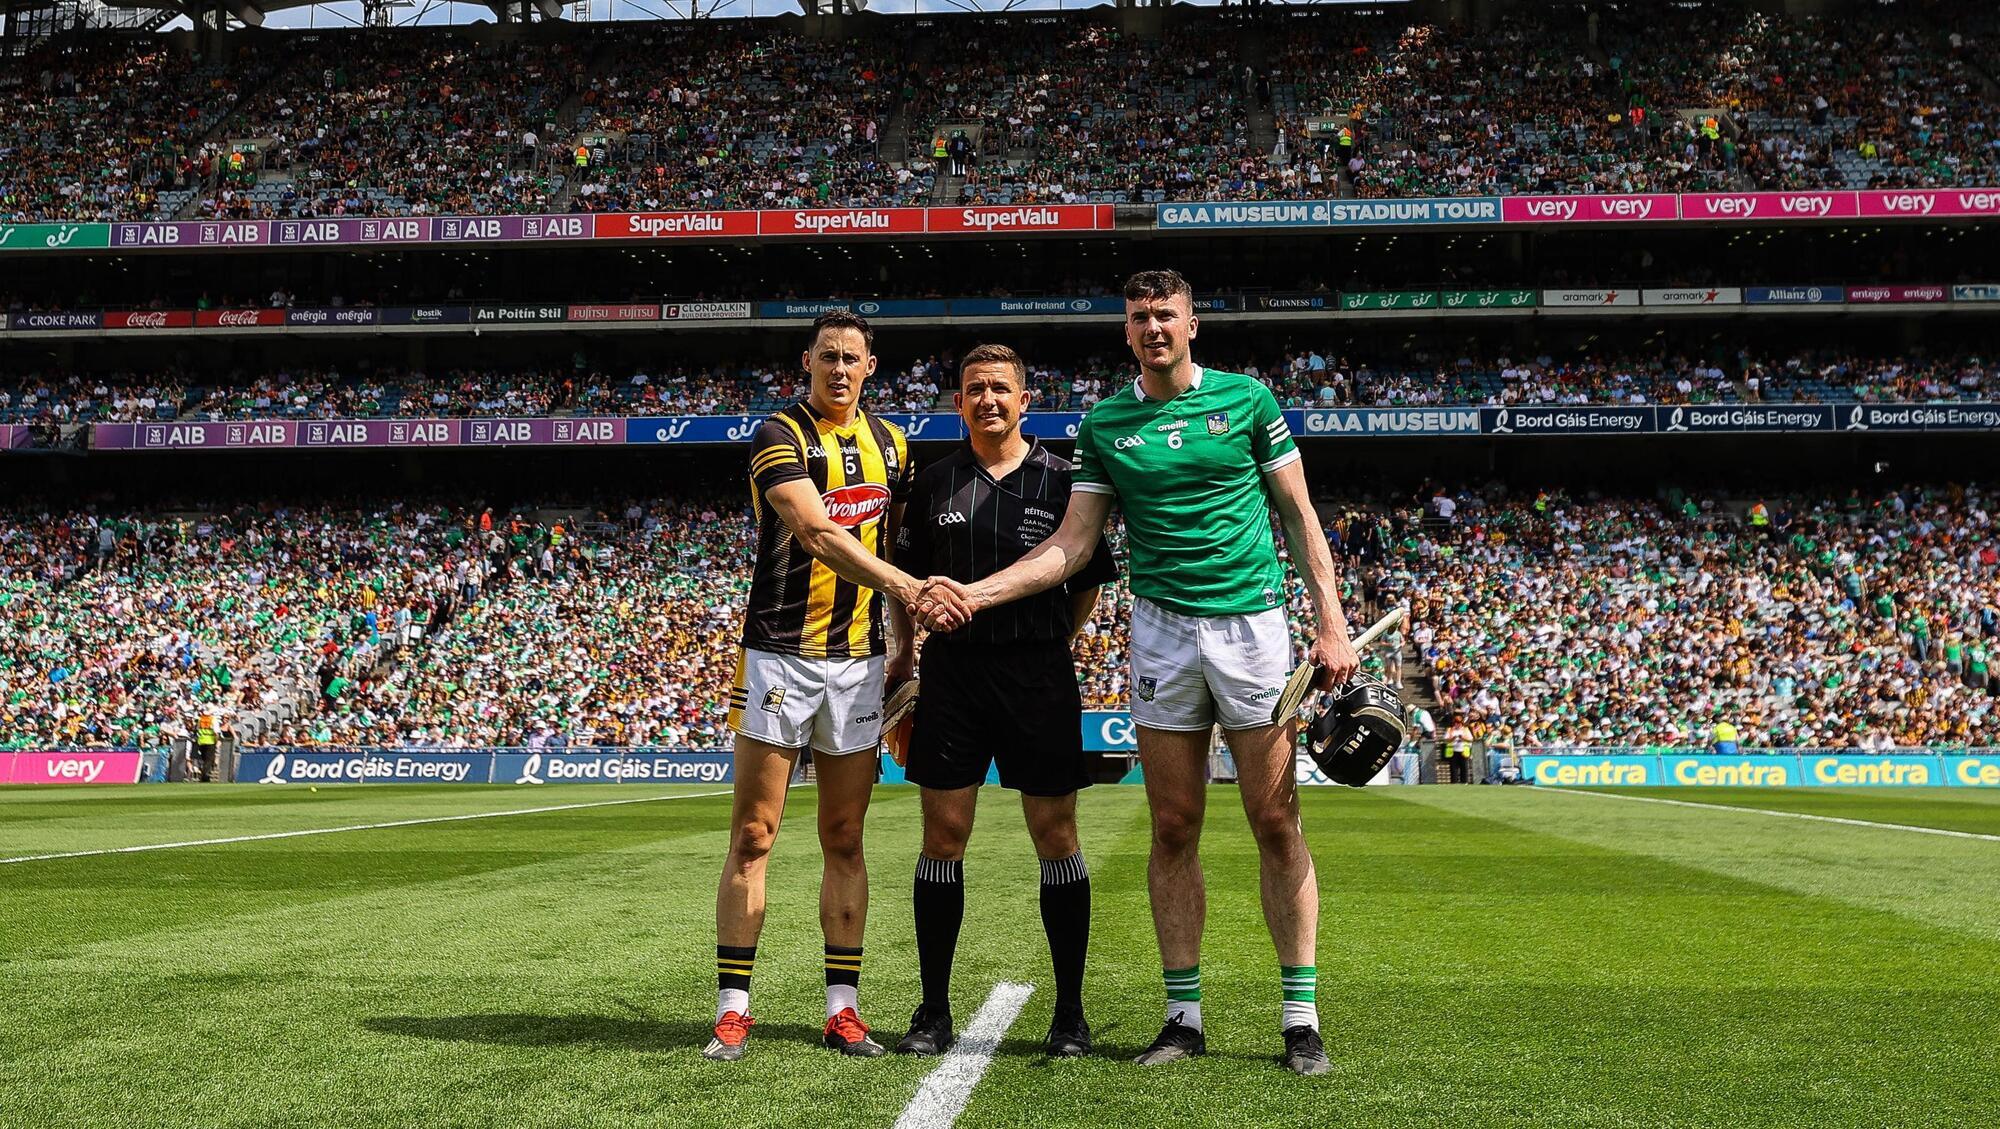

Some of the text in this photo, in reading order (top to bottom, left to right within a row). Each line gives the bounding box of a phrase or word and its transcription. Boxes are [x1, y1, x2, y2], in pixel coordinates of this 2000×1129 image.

[1163, 200, 1495, 223] GAA MUSEUM & STADIUM TOUR
[1527, 200, 1578, 219] very
[1601, 198, 1652, 218] very
[1705, 196, 1756, 216] very
[1779, 195, 1831, 215] very
[1883, 194, 1935, 214] very
[1959, 193, 2000, 214] ver
[464, 219, 501, 238] AIB
[545, 217, 583, 236] AIB
[629, 216, 722, 237] SuperValu
[794, 212, 889, 234] SuperValu
[963, 208, 1058, 230] SuperValu
[46, 226, 79, 248] eir
[142, 225, 179, 243] AIB
[222, 224, 258, 243] AIB
[302, 222, 339, 241] AIB
[382, 220, 419, 239] AIB
[1213, 299, 1225, 308] 0.0
[1269, 297, 1323, 308] GUINNESS 0.0
[1562, 293, 1604, 302] aramark
[1663, 292, 1704, 301] aramark
[1768, 289, 1806, 300] Allianz
[1852, 289, 1891, 302] entegro
[1903, 288, 1943, 301] entegro
[417, 308, 442, 317] Bostik
[478, 307, 562, 319] An Poitín Stil
[573, 308, 608, 320] FUJITSU
[618, 308, 654, 319] FUJITSU
[682, 304, 746, 313] CLONDALKIN
[786, 305, 808, 313] Bank
[809, 305, 817, 313] of
[1001, 301, 1066, 310] Bank of Ireland
[30, 315, 96, 327] CROKE PARK
[1307, 411, 1478, 432] GAA MUSEUM
[1515, 412, 1642, 431] Bord Gáis Energy
[1691, 411, 1821, 430] Bord Gáis Energy
[1871, 410, 1908, 425] Bord
[1911, 409, 1945, 425] Gáis
[168, 426, 205, 445] AIB
[248, 425, 285, 444] AIB
[330, 424, 367, 443] AIB
[412, 423, 449, 442] AIB
[494, 422, 531, 441] AIB
[576, 420, 613, 440] AIB
[656, 418, 690, 442] eir
[727, 417, 761, 441] eir
[1167, 431, 1182, 449] 6
[47, 759, 105, 784] very
[291, 758, 471, 782] Bord Gáis Energy
[547, 757, 729, 781] Bord Gáis Energy
[1536, 759, 1647, 784] Centra
[1675, 759, 1787, 785] Centra
[1815, 759, 1929, 784] Centra
